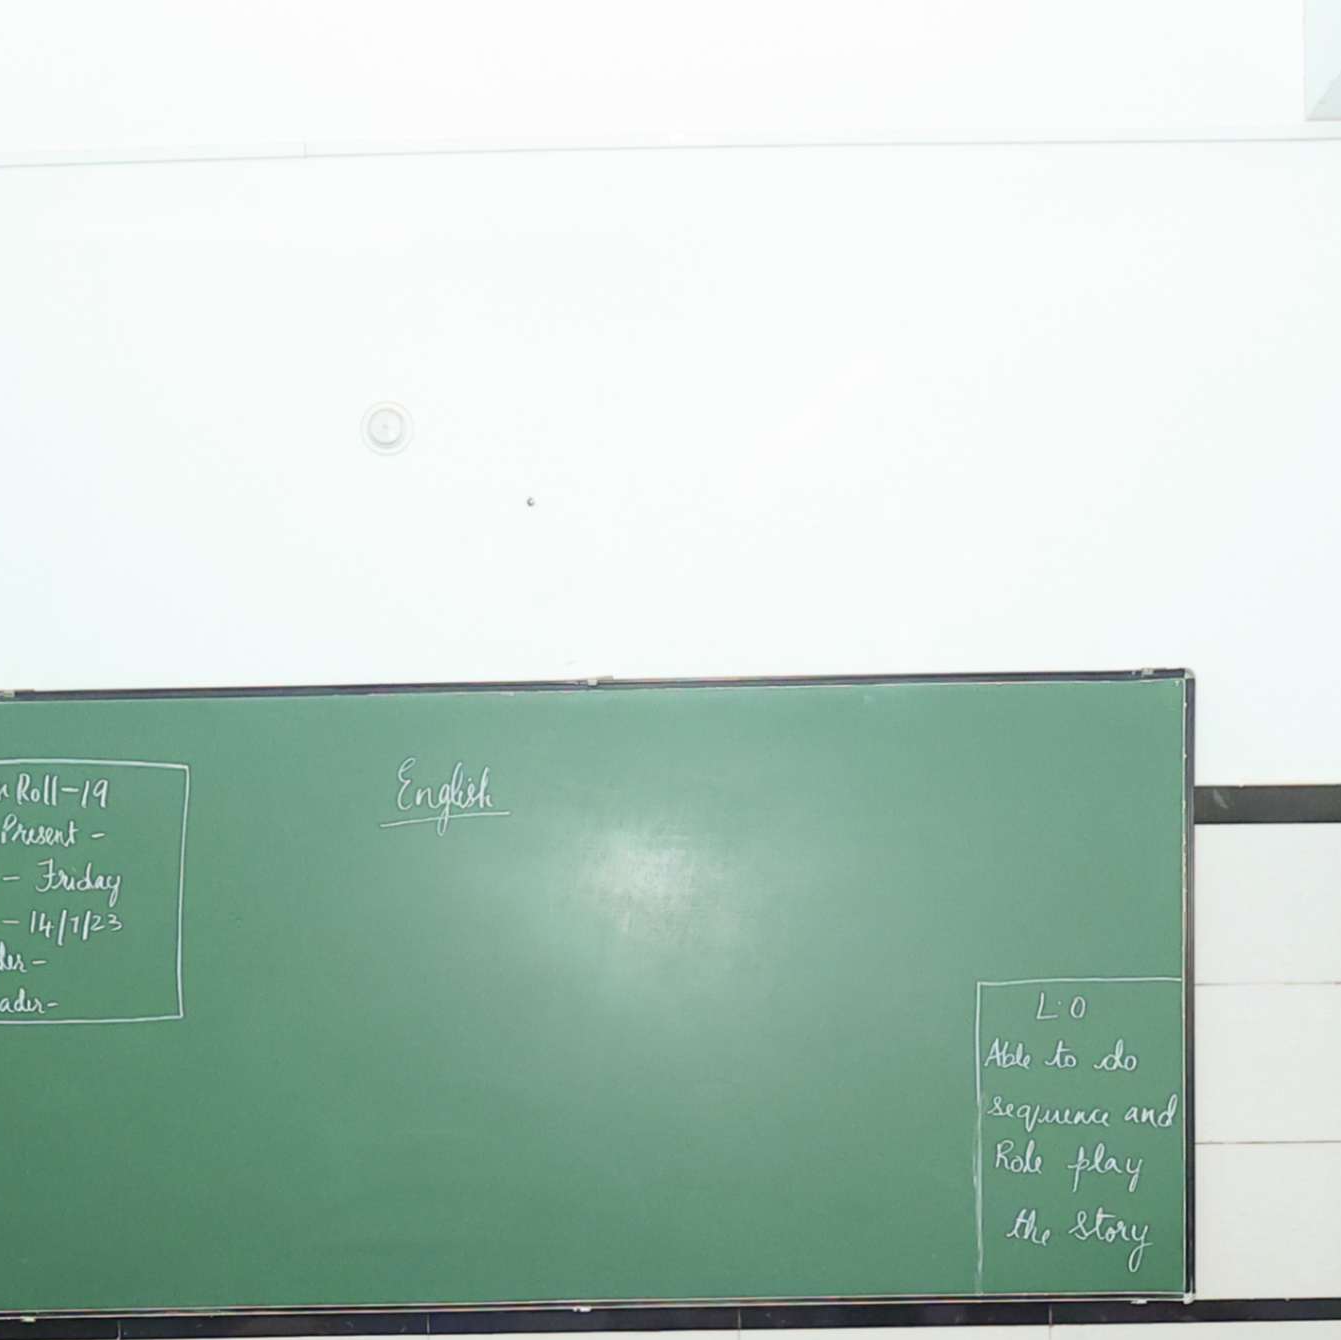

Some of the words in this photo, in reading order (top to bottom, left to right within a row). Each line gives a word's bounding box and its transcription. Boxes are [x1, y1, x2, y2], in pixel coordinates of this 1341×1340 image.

[396, 756, 495, 836] English
[0, 813, 79, 847] Present
[34, 858, 122, 906] Friday
[983, 1037, 1031, 1070] Able
[1044, 1039, 1078, 1069] to
[1092, 1038, 1139, 1072] do
[1123, 1093, 1178, 1128] and
[995, 1139, 1043, 1175] Role
[1067, 1143, 1144, 1193] play
[1006, 1207, 1052, 1246] the
